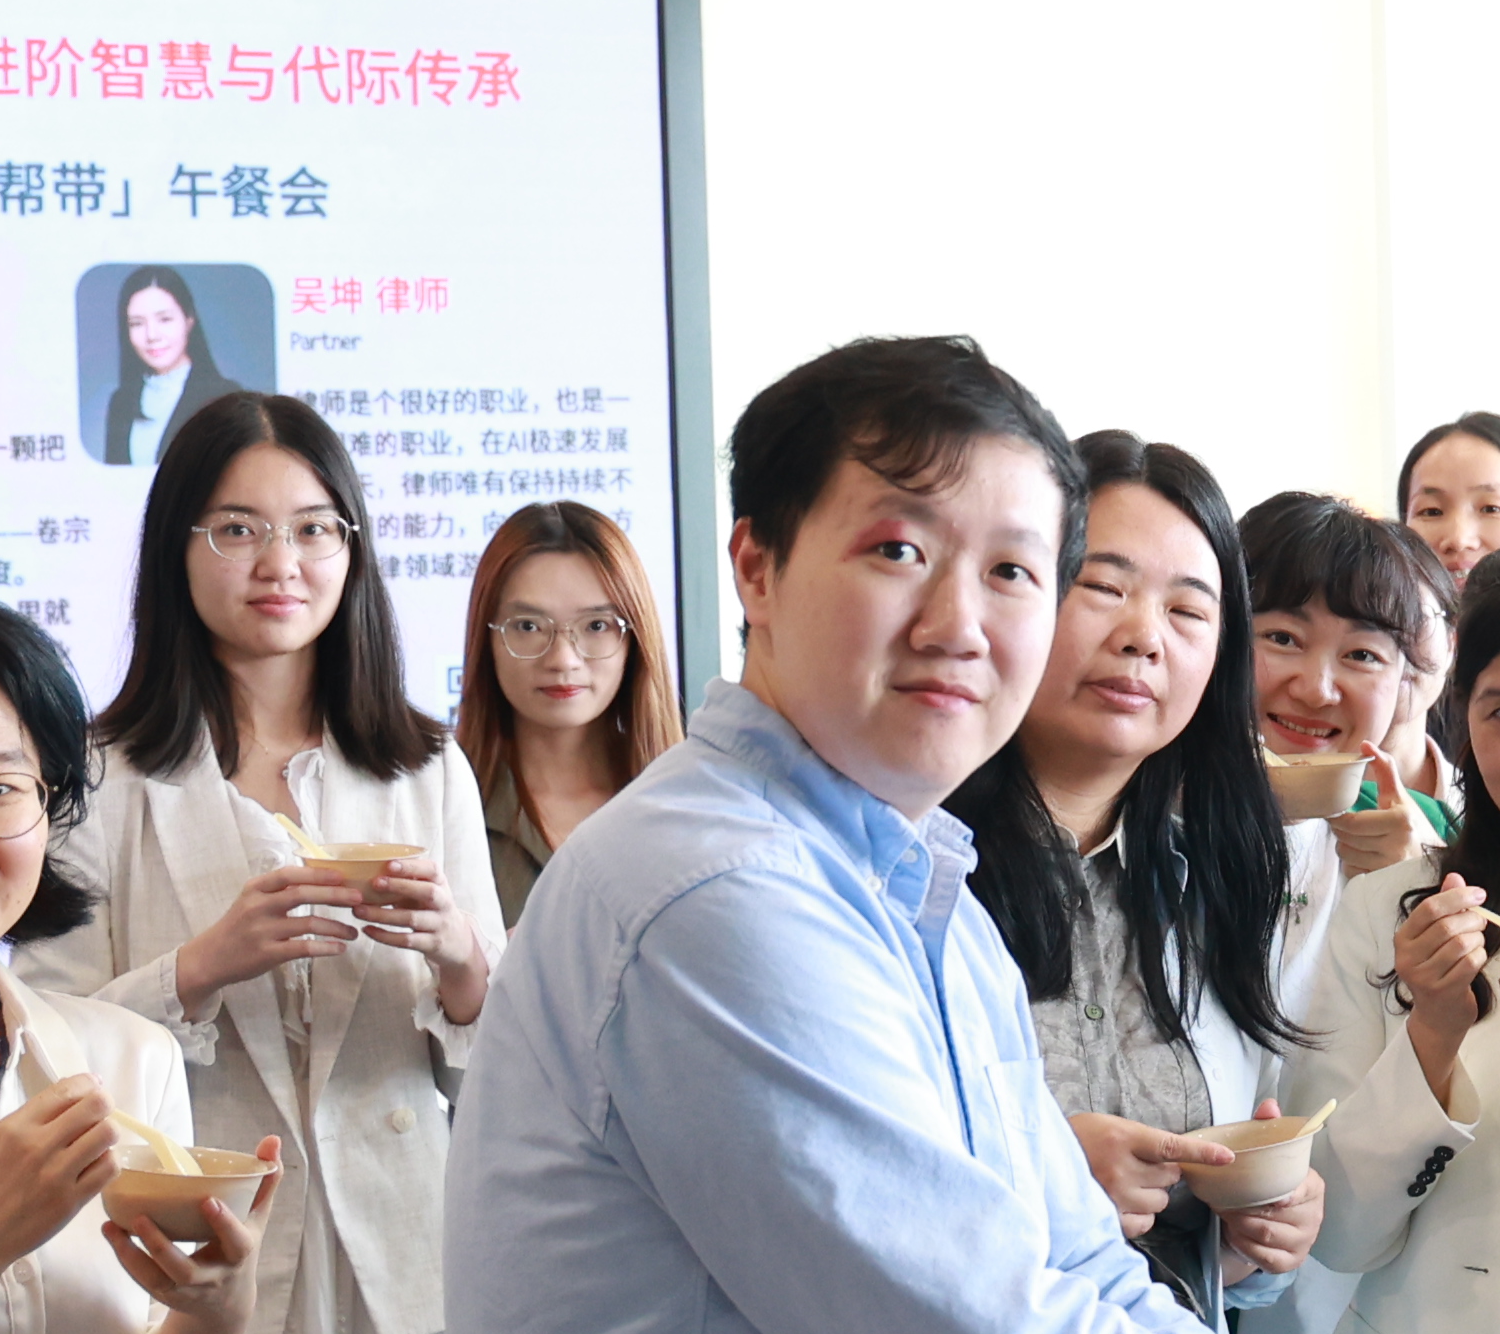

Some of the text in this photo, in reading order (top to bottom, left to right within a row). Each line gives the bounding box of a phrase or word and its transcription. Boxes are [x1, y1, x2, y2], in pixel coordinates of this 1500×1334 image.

[291, 276, 450, 315] 吴坤 律师
[290, 330, 363, 352] Partner
[340, 427, 629, 457] 难的职业，在AI极速发展
[368, 511, 501, 540] 的能力，向
